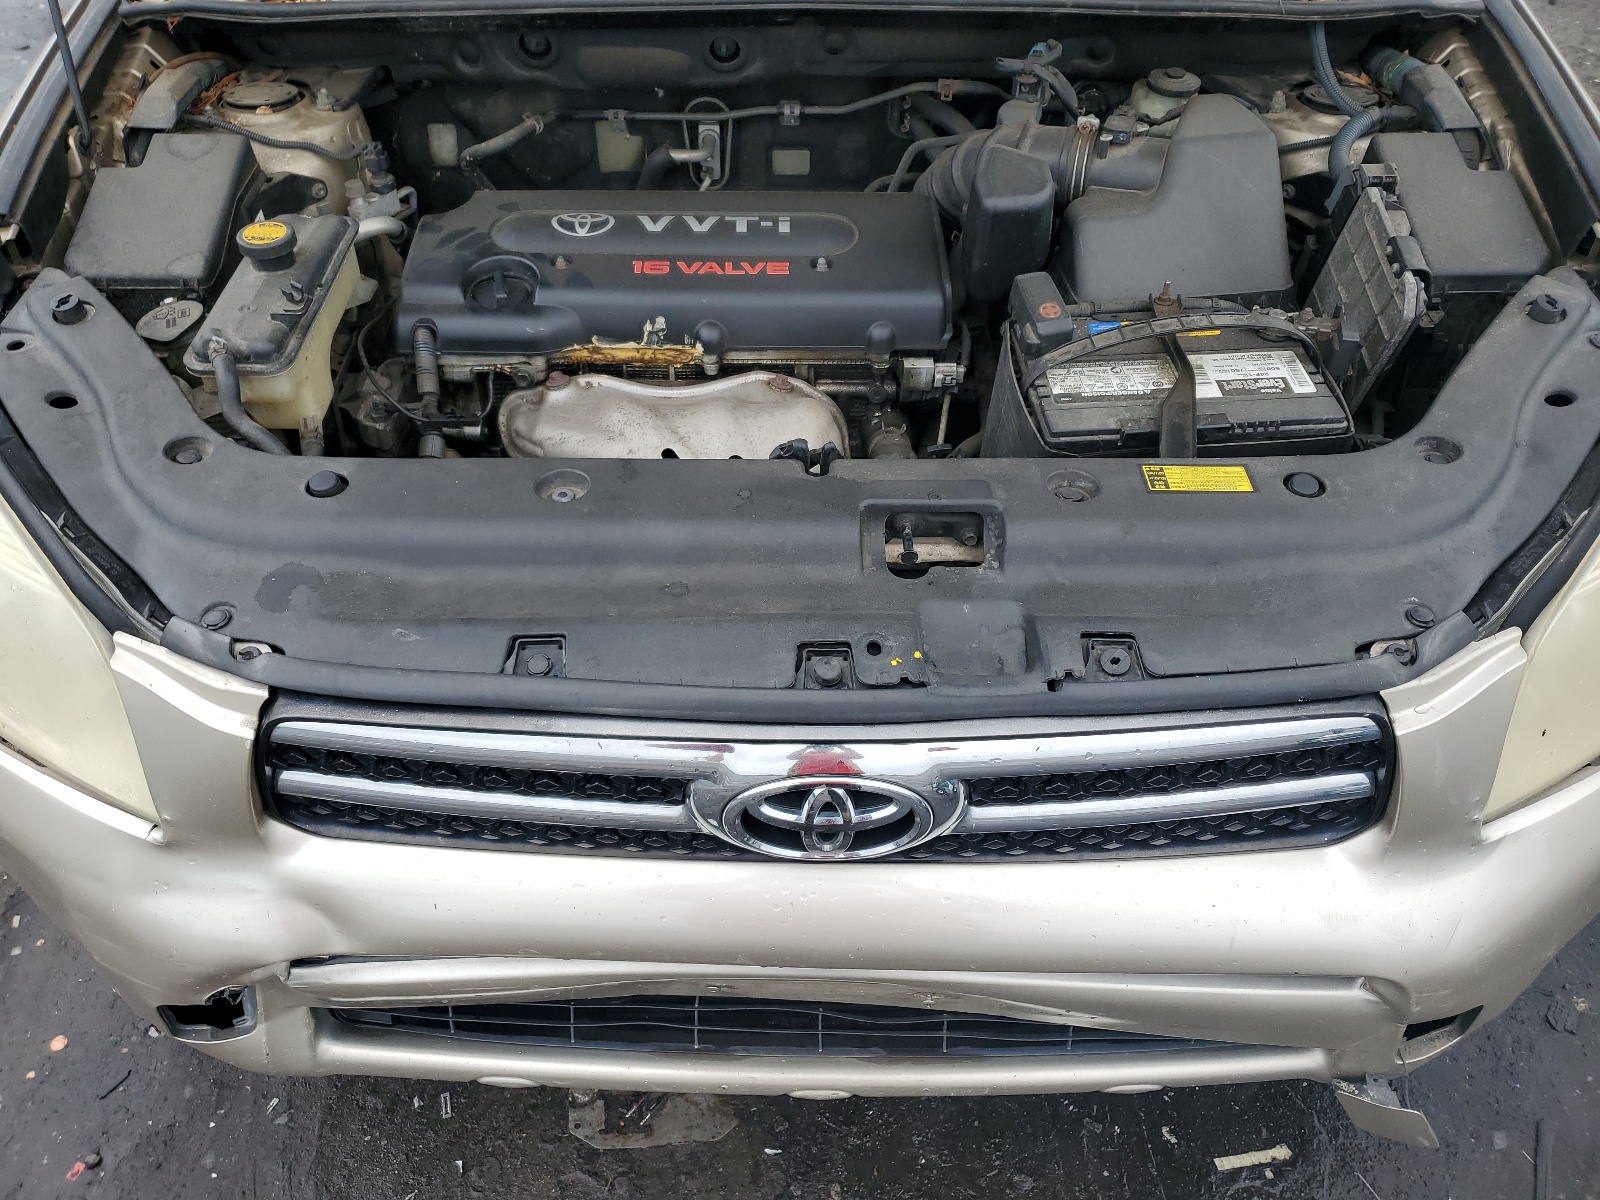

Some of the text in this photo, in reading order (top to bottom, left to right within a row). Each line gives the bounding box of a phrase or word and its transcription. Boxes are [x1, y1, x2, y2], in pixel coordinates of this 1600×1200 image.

[636, 215, 791, 233] VVT-i
[632, 260, 790, 275] 16 VALVE
[1221, 378, 1286, 390] EverStart
